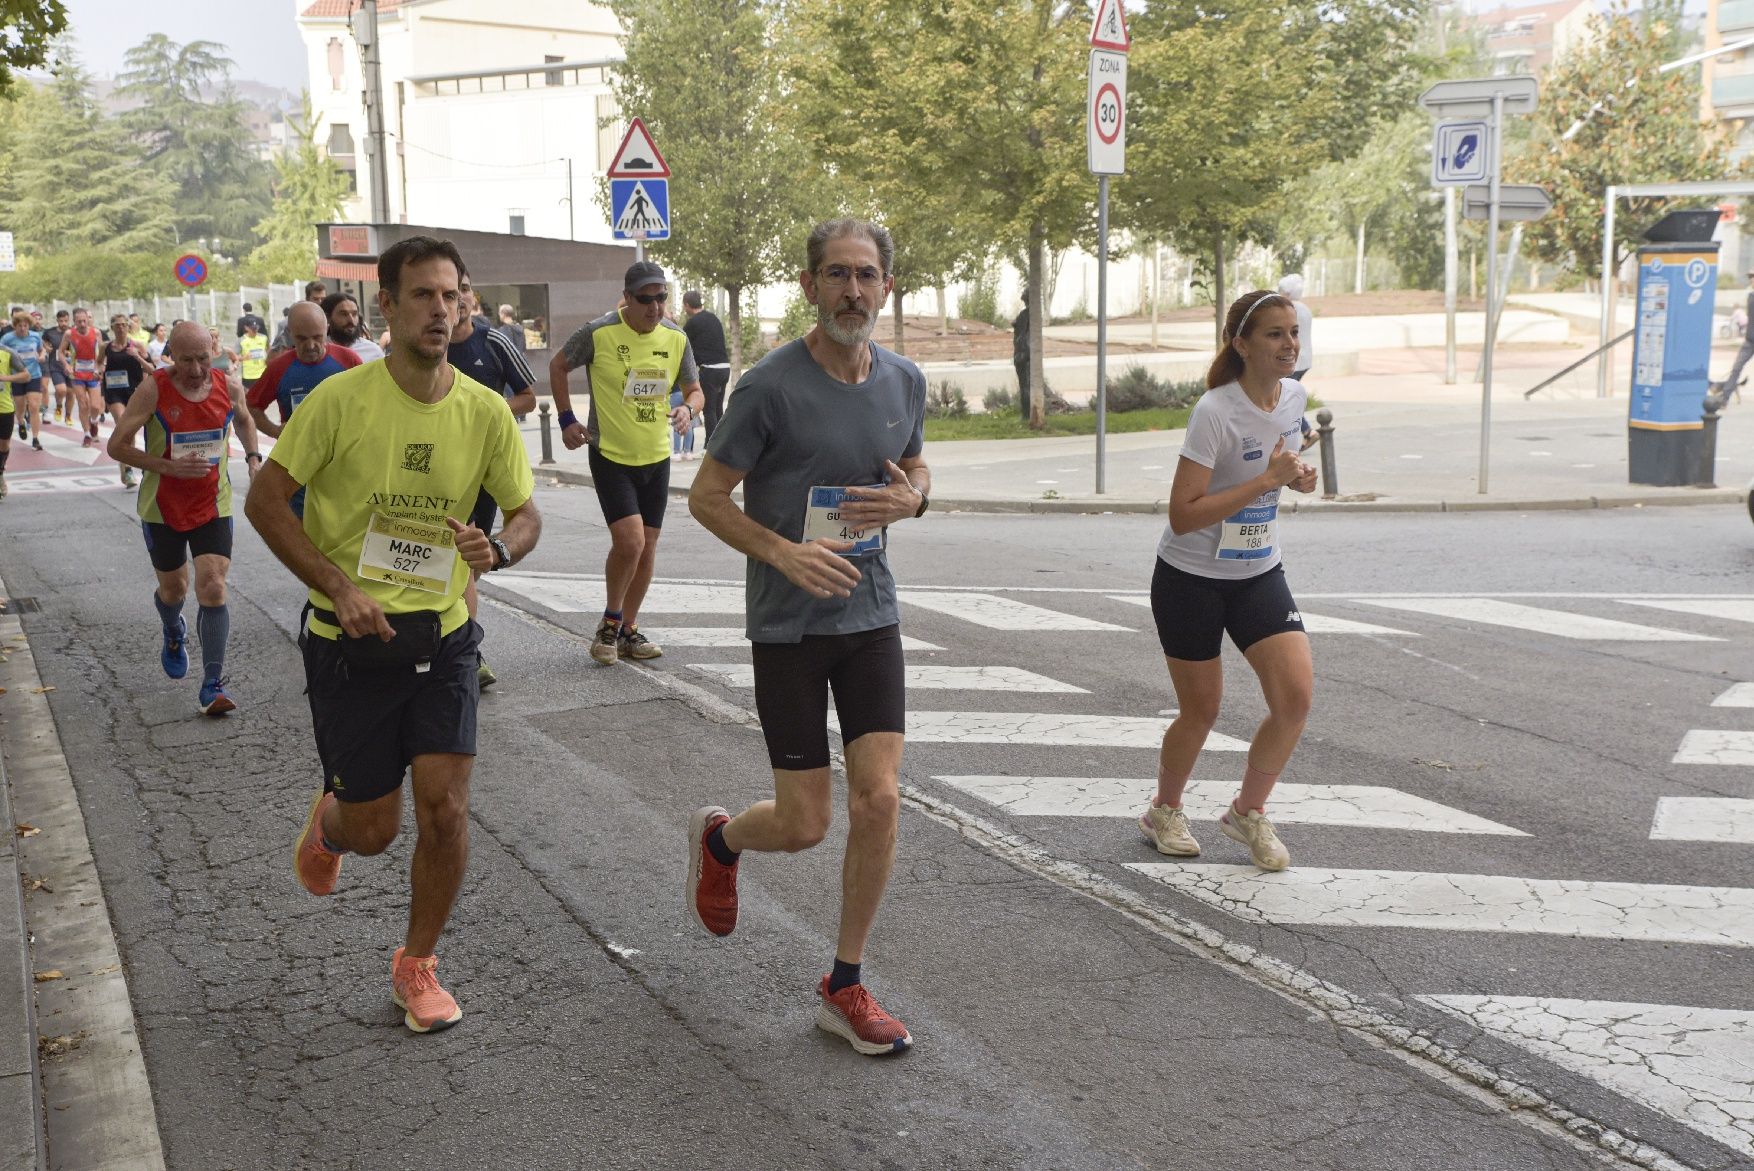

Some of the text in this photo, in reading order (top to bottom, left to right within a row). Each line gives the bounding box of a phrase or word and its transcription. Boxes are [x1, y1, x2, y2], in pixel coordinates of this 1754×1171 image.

[1100, 58, 1120, 73] ZONA
[1101, 103, 1116, 123] 30
[633, 383, 656, 395] 647
[366, 492, 453, 511] AVINENT
[1240, 523, 1268, 536] BERTA
[389, 539, 433, 560] MARC
[1246, 538, 1261, 548] 188
[393, 557, 420, 572] 527
